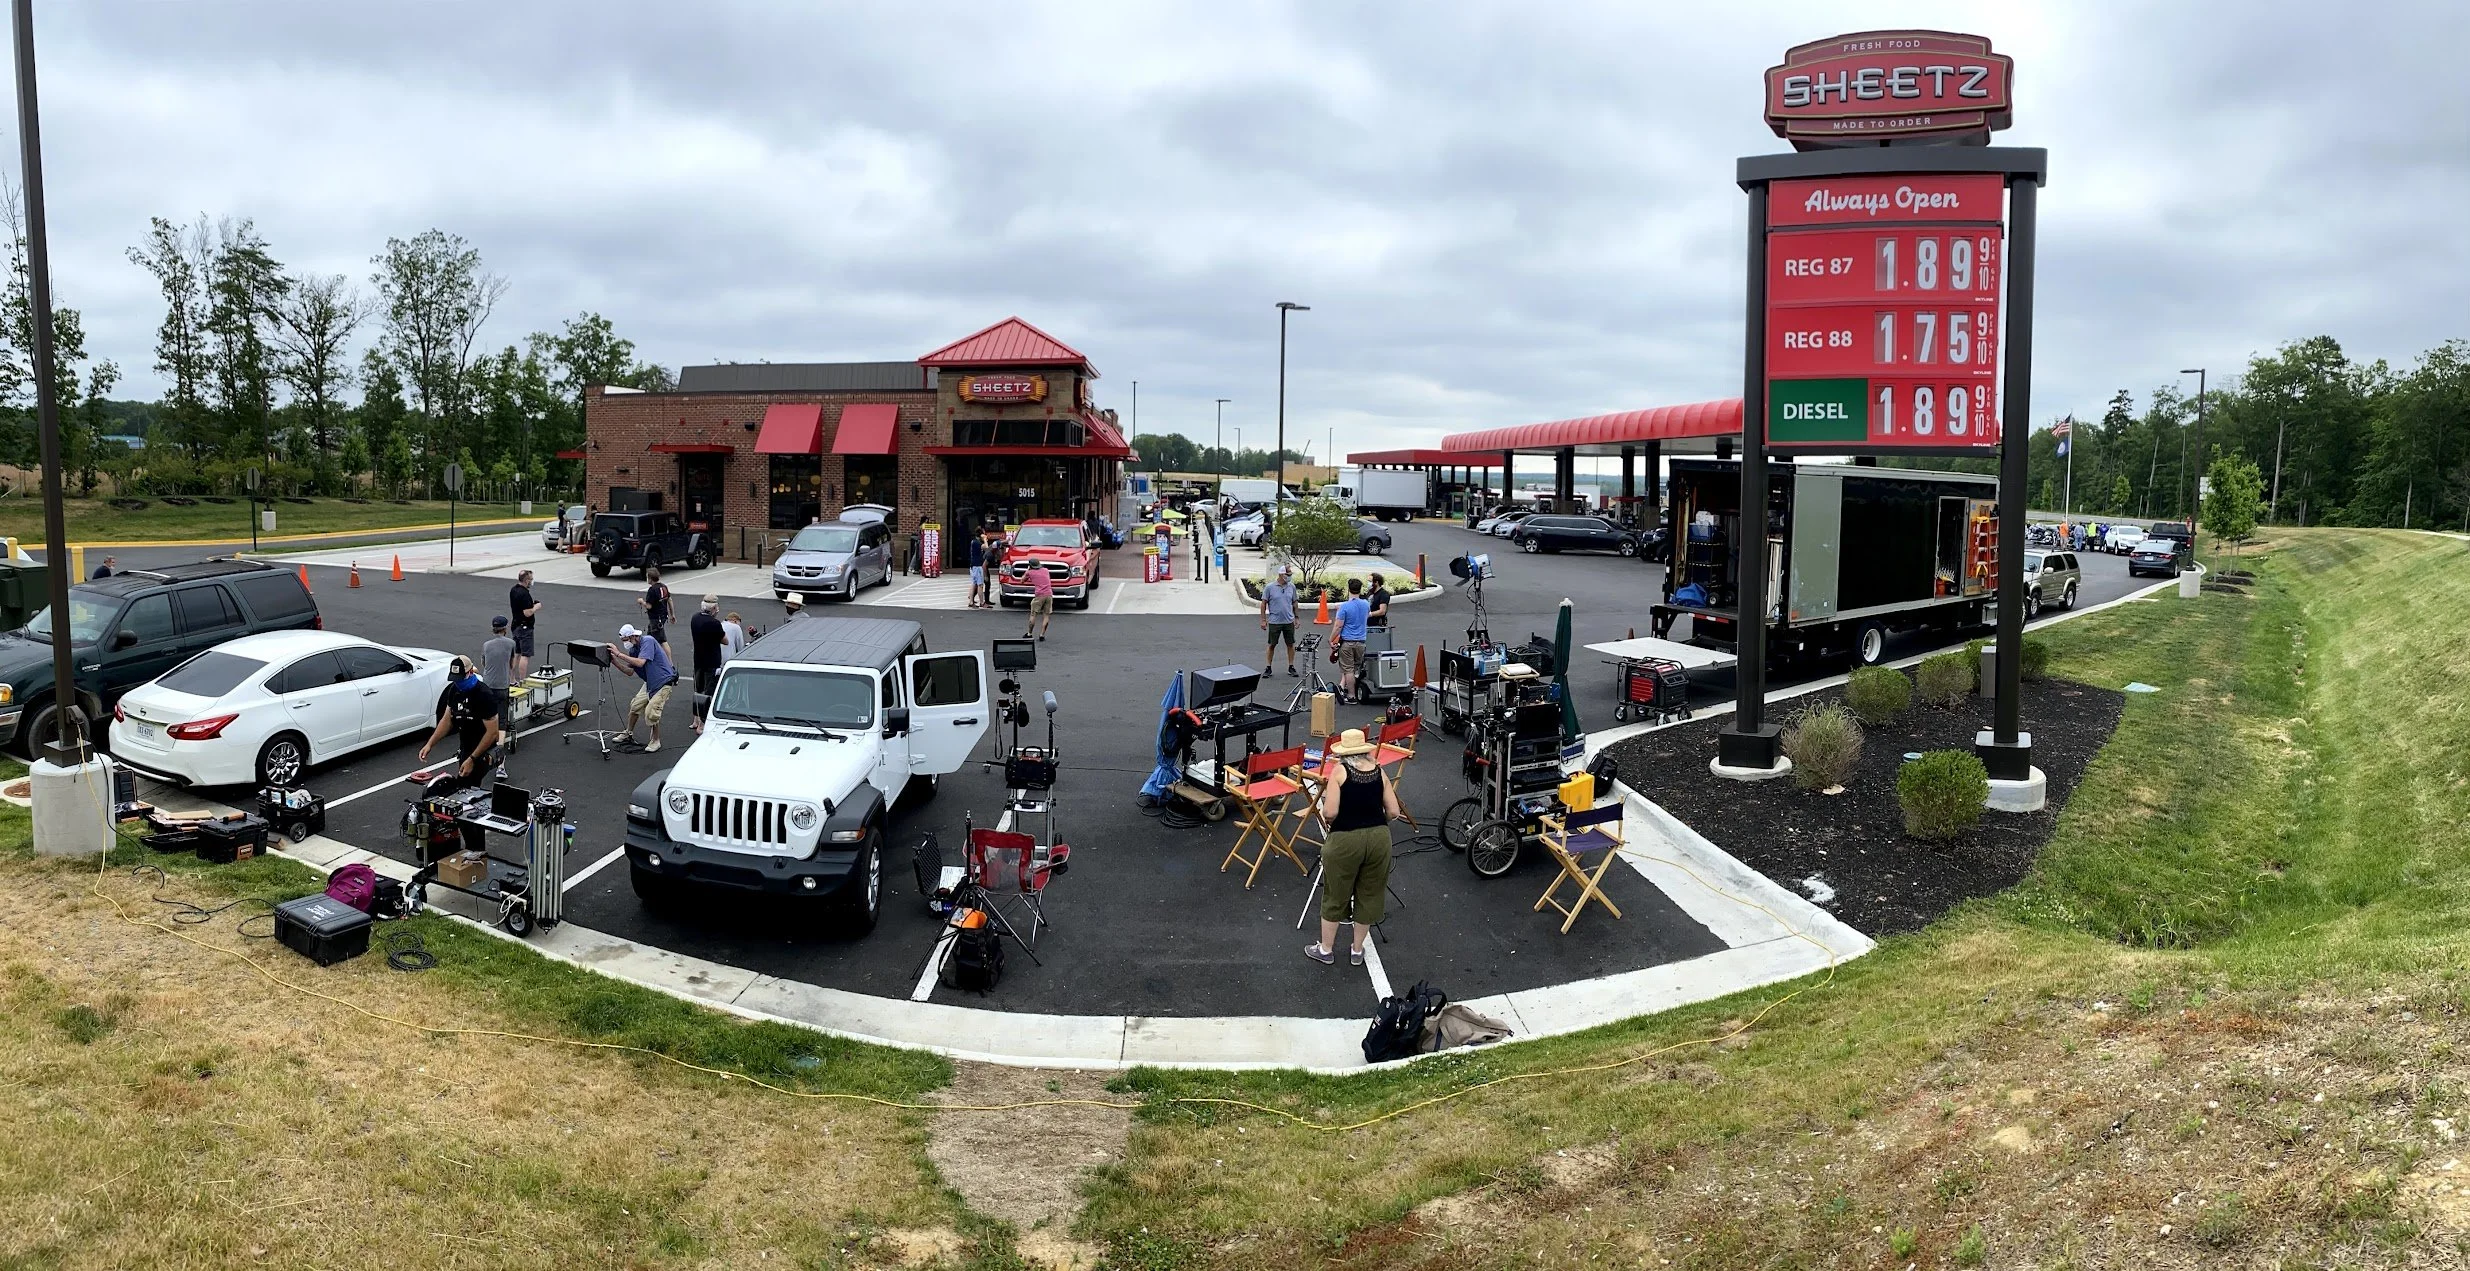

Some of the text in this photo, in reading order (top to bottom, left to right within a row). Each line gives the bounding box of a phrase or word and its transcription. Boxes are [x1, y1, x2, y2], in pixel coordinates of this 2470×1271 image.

[1843, 40, 1921, 52] FRESH FOOD
[1783, 65, 1988, 107] SHEETZ
[1833, 117, 1931, 129] MADE TO ORDER
[1804, 186, 1960, 216] Always Open
[1785, 258, 1824, 276] REG
[1829, 257, 1854, 275] 87
[1784, 331, 1823, 349] REG
[1828, 330, 1853, 347] 88
[973, 382, 1031, 393] SHEETZ
[1783, 402, 1849, 420] DIESEL
[1018, 487, 1035, 498] 5015
[923, 529, 931, 566] CURBSIDE
[931, 530, 939, 557] PICKUP
